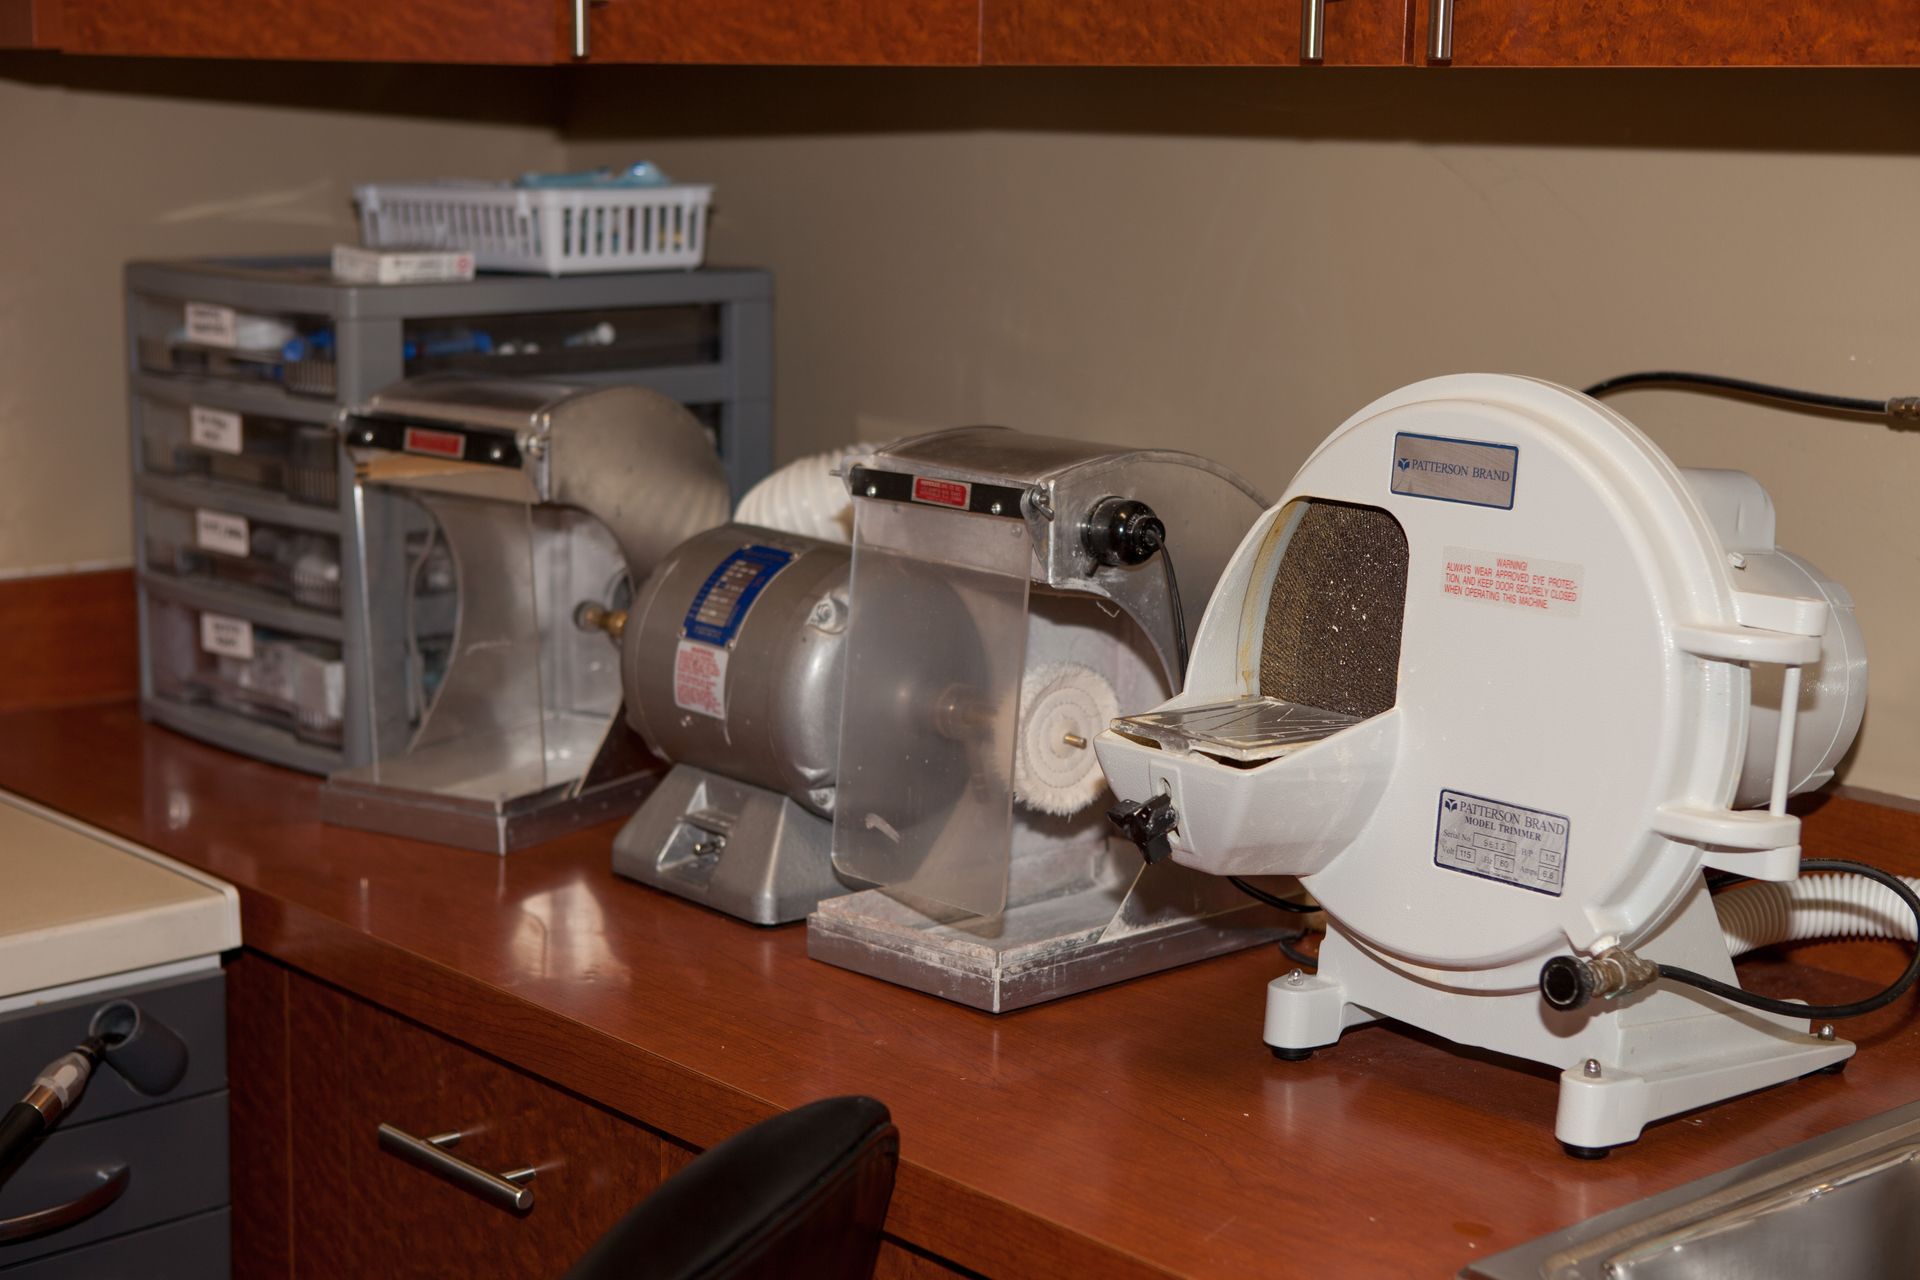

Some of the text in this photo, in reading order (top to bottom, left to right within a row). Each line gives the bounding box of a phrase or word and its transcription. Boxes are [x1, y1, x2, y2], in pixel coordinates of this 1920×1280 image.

[1411, 459, 1510, 482] PATTERSON BRAND
[1446, 562, 1578, 590] ALWAYS WEAR APPROVED EYE PROTEC-
[1462, 575, 1476, 586] AND
[1477, 578, 1493, 588] KEEP
[1495, 581, 1514, 592] DOOR
[1516, 583, 1549, 597] SECURELY
[1550, 589, 1577, 602] CLOSED
[1444, 583, 1463, 595] WHEN
[1464, 586, 1500, 601] OPERATING
[1502, 593, 1517, 605] THIS
[1460, 801, 1565, 836] PATTERSON BRAND
[1465, 815, 1542, 842] MODEL TRIMMER
[1442, 829, 1459, 840] Serial
[1460, 849, 1472, 860] 115
